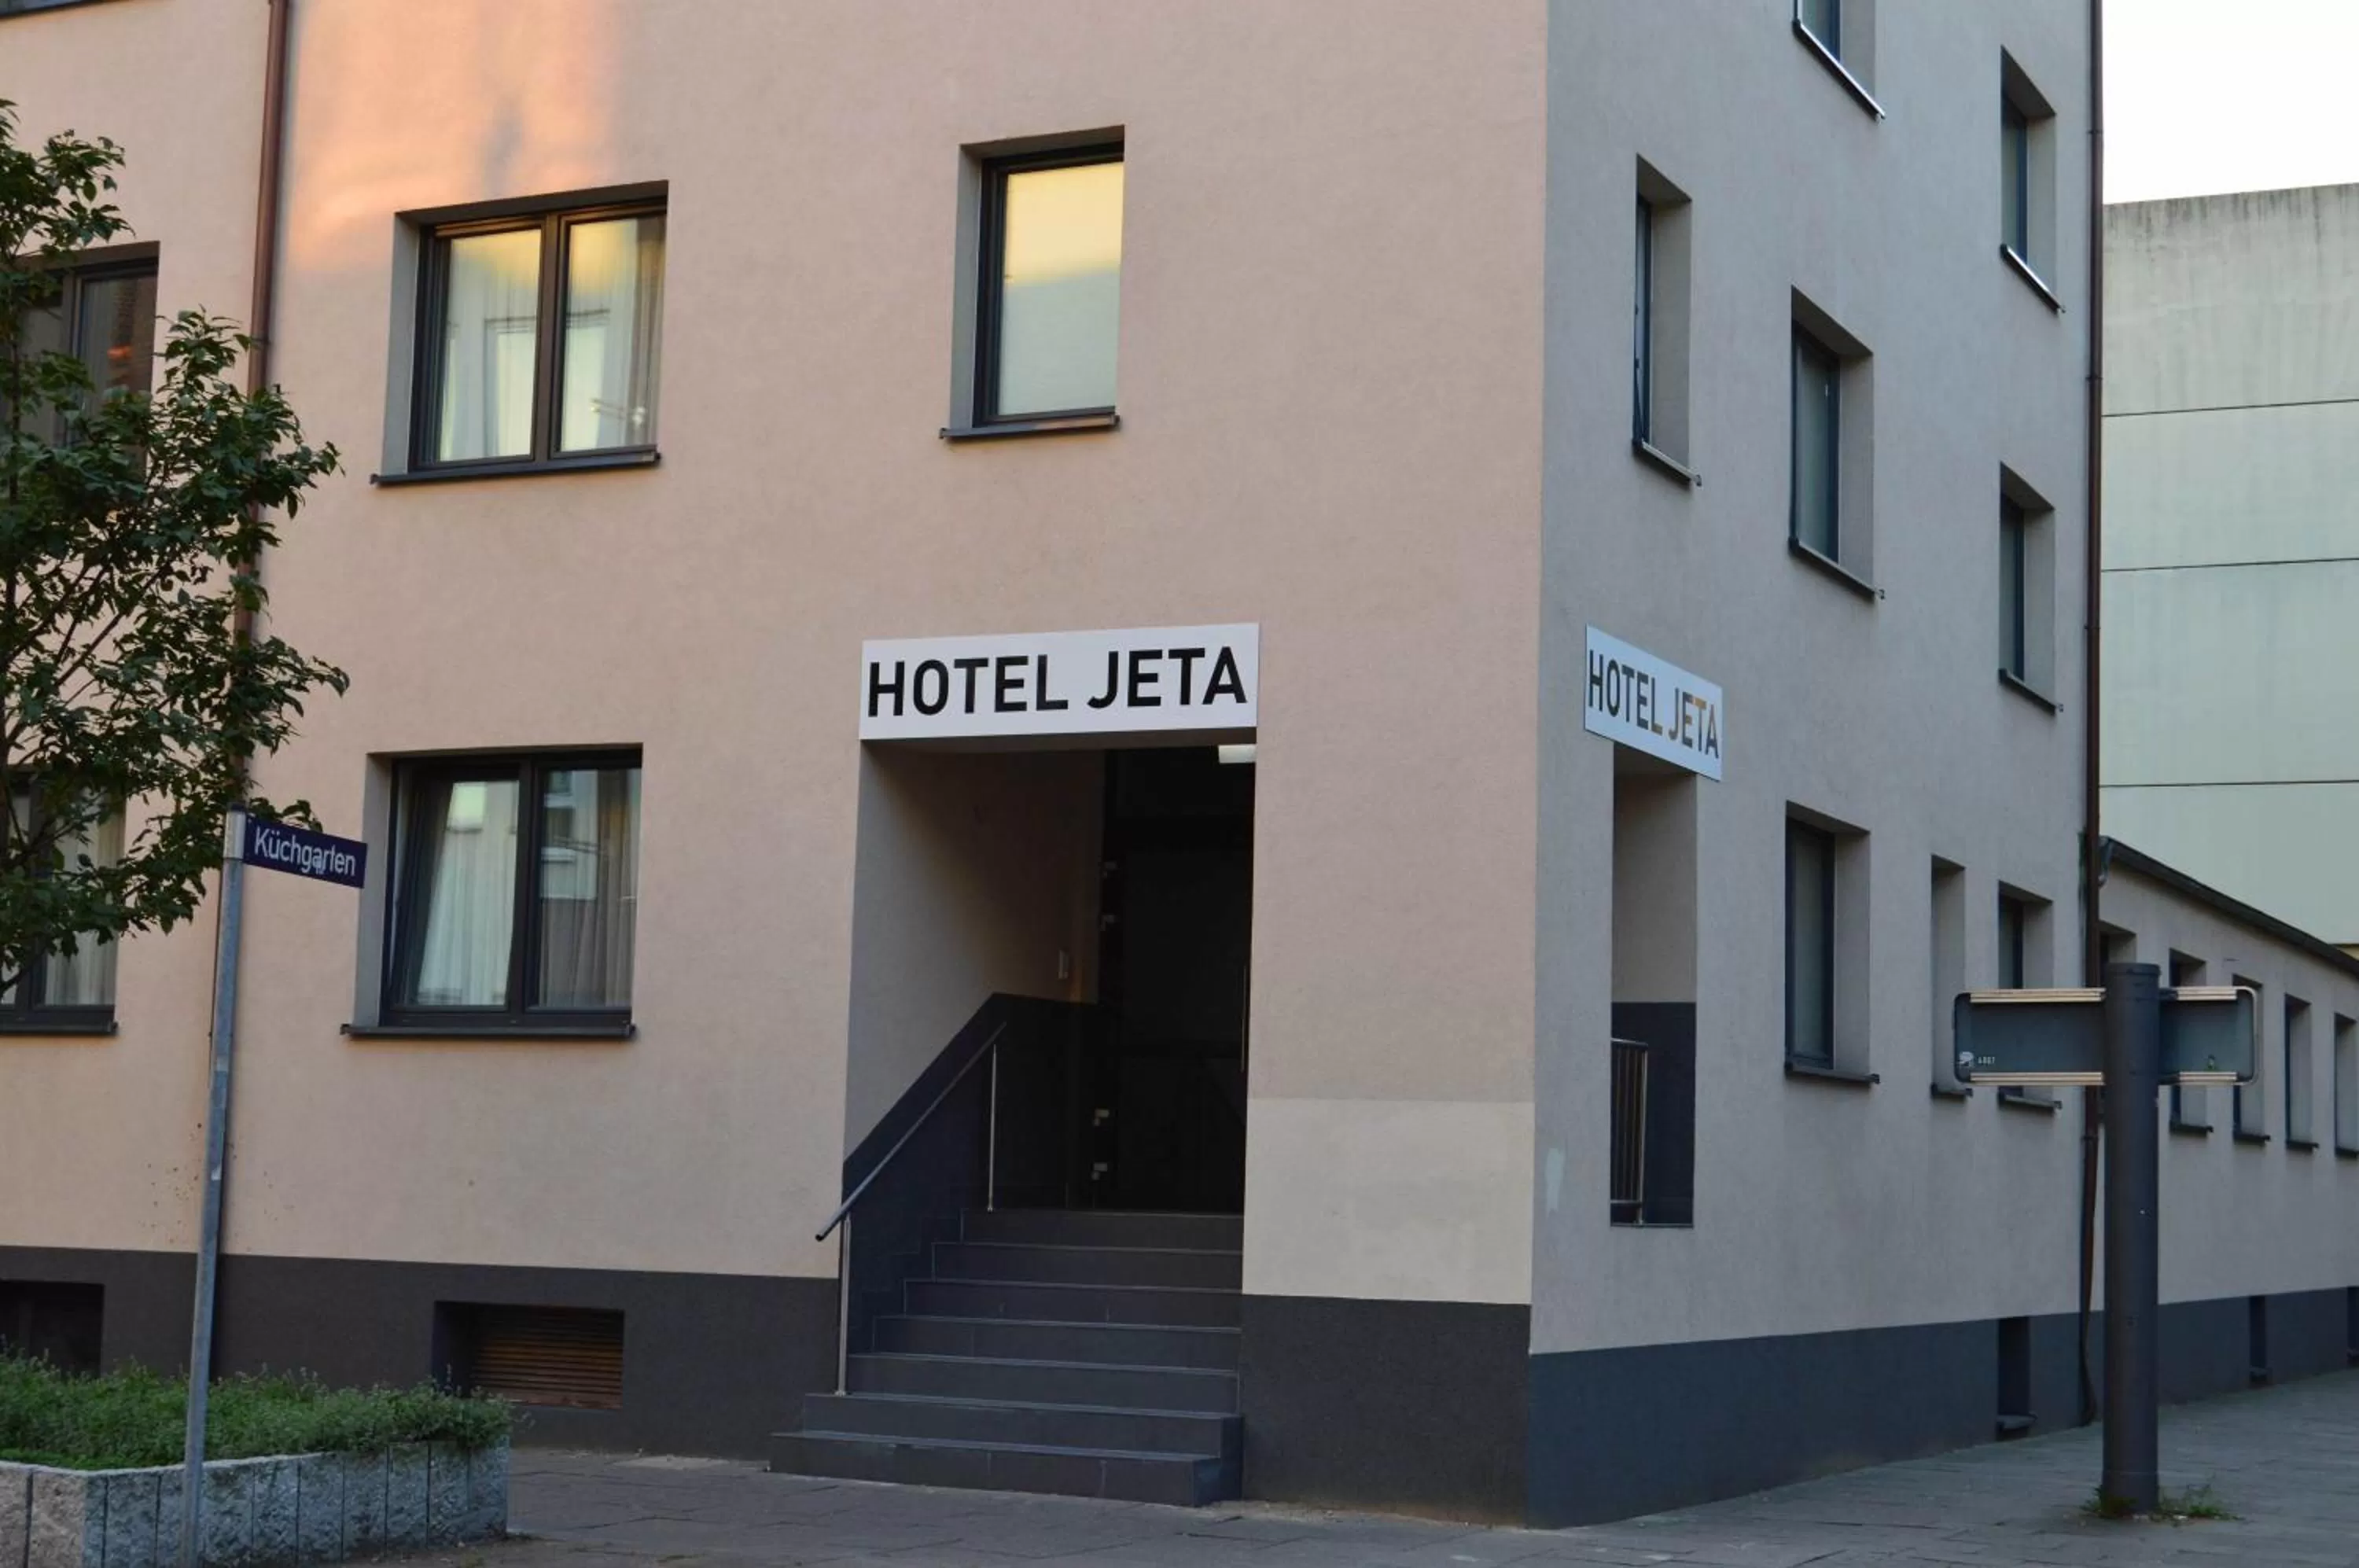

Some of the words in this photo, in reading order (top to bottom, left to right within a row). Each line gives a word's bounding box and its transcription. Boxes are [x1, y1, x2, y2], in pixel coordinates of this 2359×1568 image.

[867, 654, 1069, 718] HOTEL
[1086, 646, 1248, 709] JETA
[1588, 649, 1663, 737] HOTEL
[1668, 686, 1720, 760] JETA
[254, 826, 356, 877] Küchgarten
